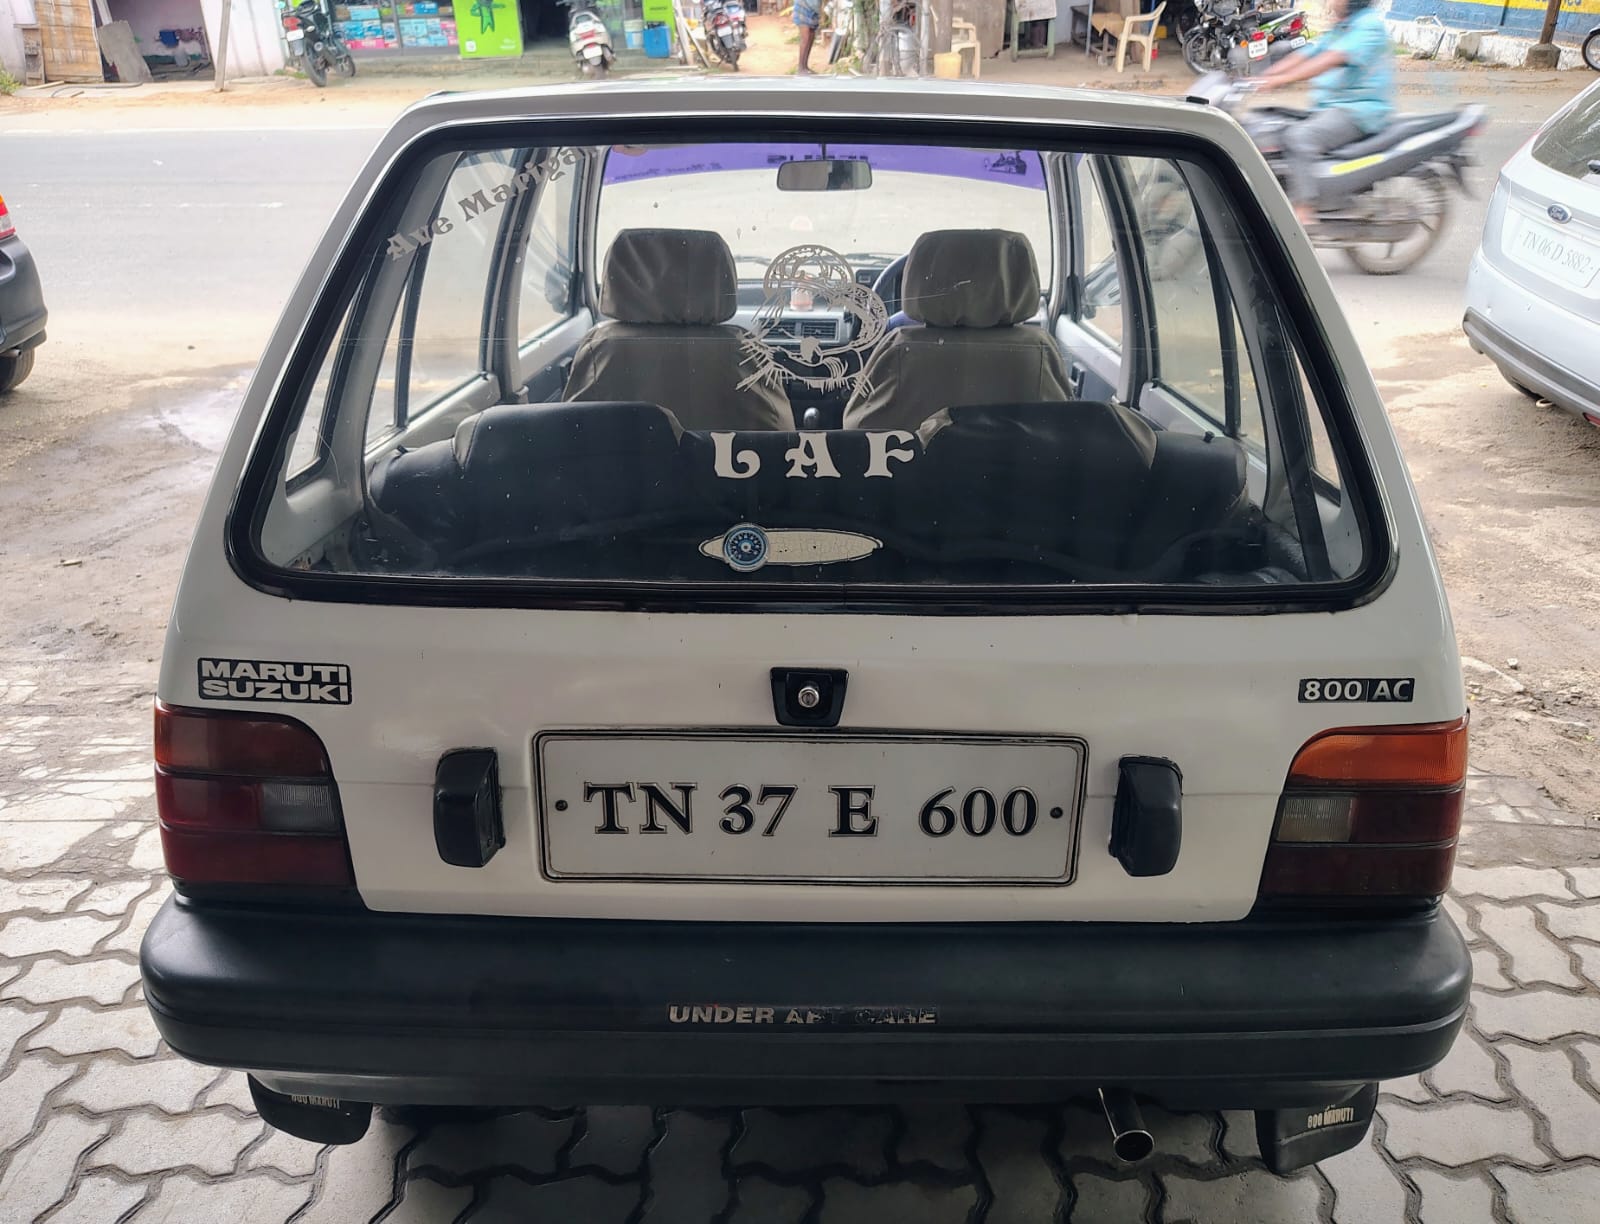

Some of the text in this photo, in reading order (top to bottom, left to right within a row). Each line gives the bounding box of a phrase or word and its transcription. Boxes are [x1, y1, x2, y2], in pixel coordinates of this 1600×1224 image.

[387, 217, 454, 261] Ave
[1522, 231, 1592, 274] TN 06 D 5882
[201, 660, 348, 683] MARUTI
[202, 679, 349, 702] SUZUKI
[1304, 680, 1411, 701] 800 AC
[583, 782, 1039, 837] TN 37 E 600
[668, 1005, 775, 1024] UNDER
[1307, 1112, 1323, 1129] 800
